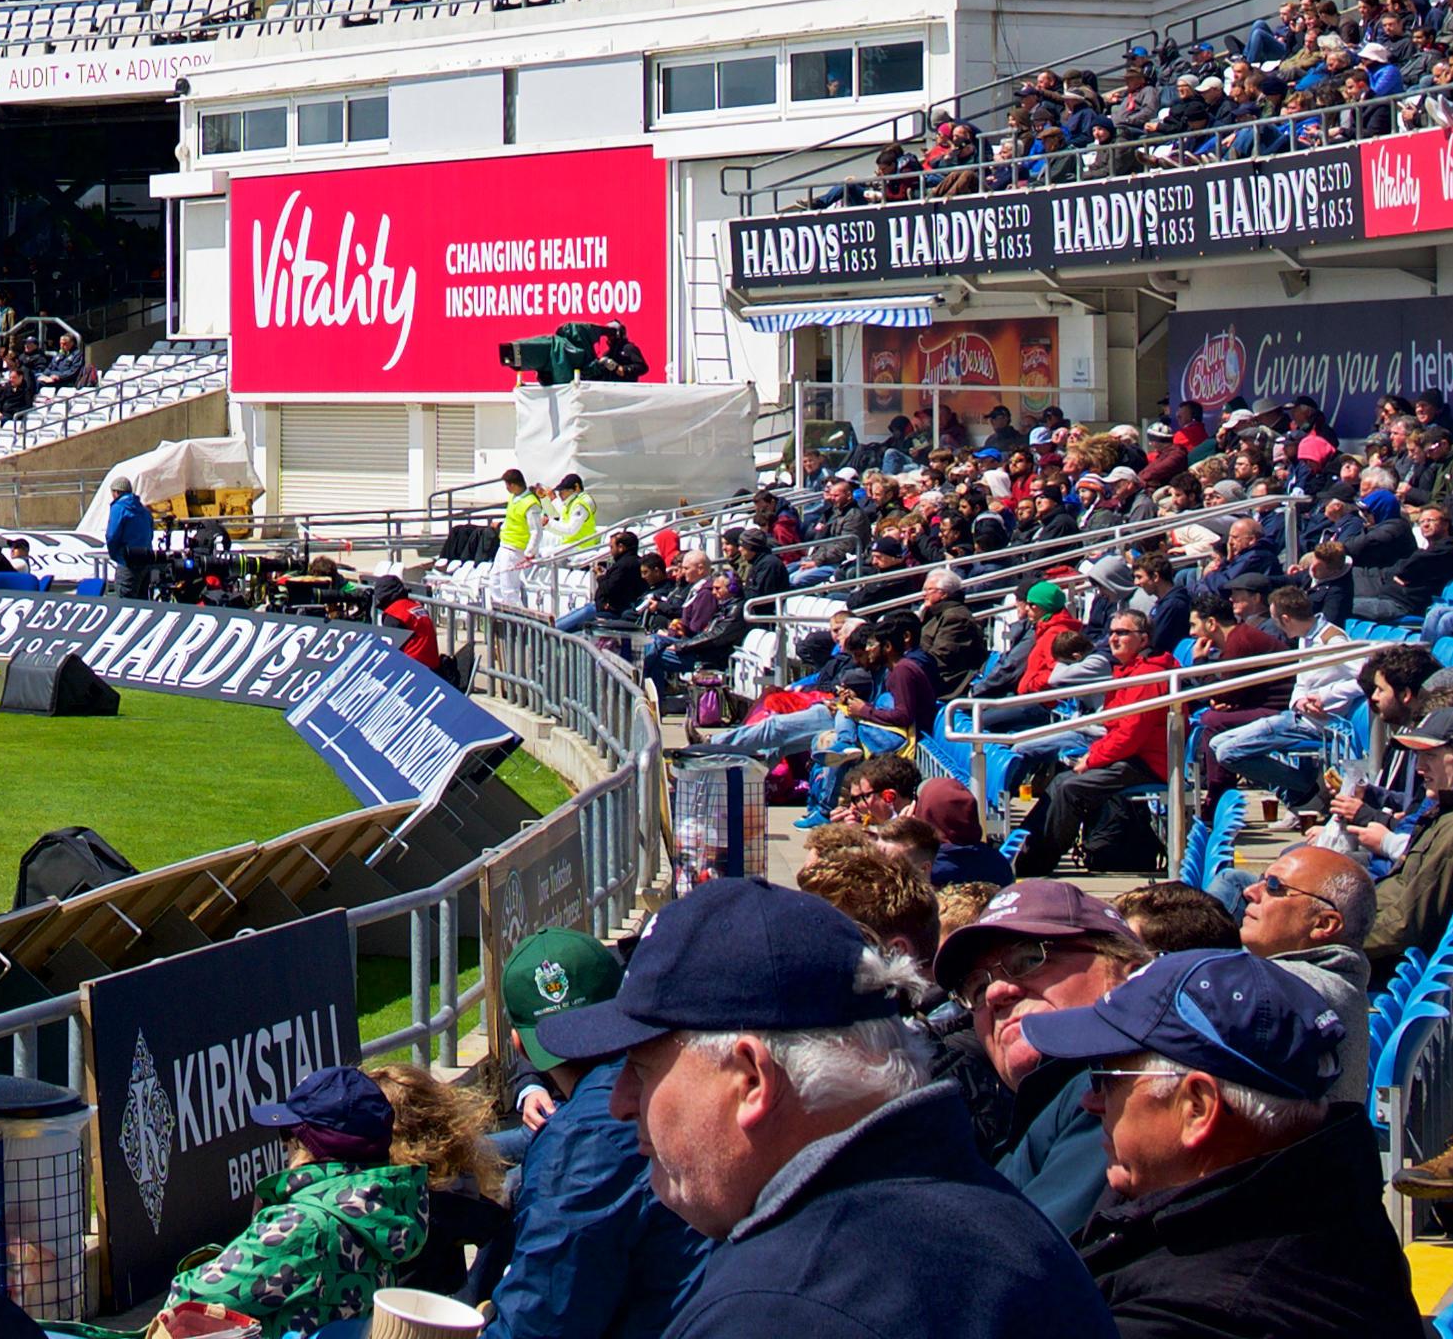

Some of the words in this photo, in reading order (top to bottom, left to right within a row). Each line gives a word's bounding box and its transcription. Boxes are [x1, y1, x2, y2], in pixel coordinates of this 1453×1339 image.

[9, 65, 57, 90] AUDIT
[77, 62, 108, 84] TAX
[1206, 167, 1319, 240] HARDYS
[1319, 161, 1352, 192] ESTD
[1371, 145, 1421, 226] Vitality
[1052, 188, 1159, 254] HARDYS
[1160, 184, 1194, 211] ESTD
[1161, 217, 1195, 245] 1853
[1322, 197, 1355, 228] 1853
[446, 240, 535, 274] CHANGING
[540, 236, 608, 270] HEALTH
[740, 223, 840, 278] HARDYS
[842, 220, 876, 244] ESTD
[888, 208, 997, 268] HARDYS
[998, 204, 1031, 230] ESTD
[1000, 234, 1032, 259] 1853
[843, 248, 877, 272] 1853
[252, 190, 416, 371] Vitality
[446, 282, 543, 317] INSURANCE
[547, 282, 583, 315] FOR
[587, 280, 642, 313] GOOD
[1254, 333, 1329, 410] Giving
[1330, 351, 1379, 424] you
[1387, 351, 1403, 395] a
[24, 600, 110, 633] ESTD
[86, 607, 321, 698] HARDYS
[275, 668, 322, 704] 18
